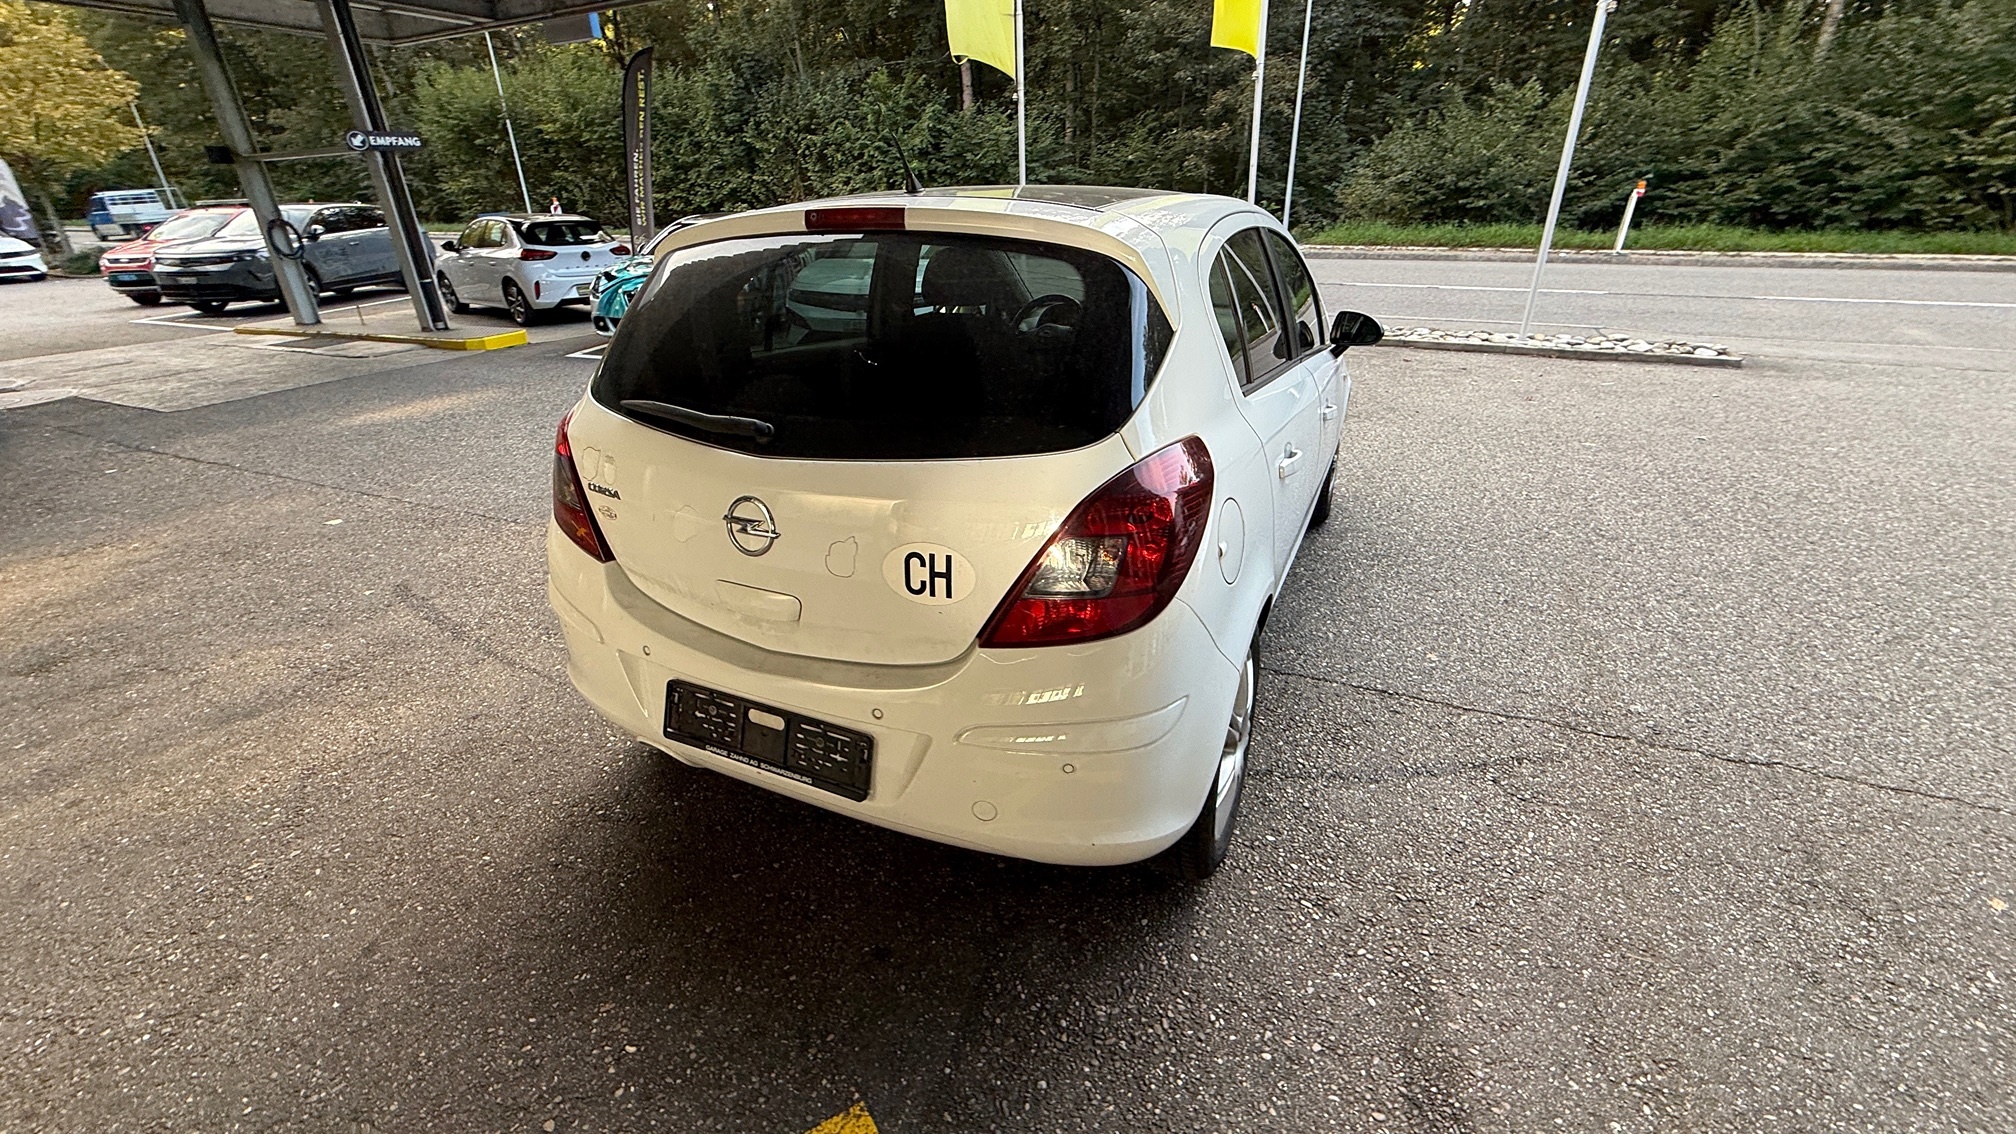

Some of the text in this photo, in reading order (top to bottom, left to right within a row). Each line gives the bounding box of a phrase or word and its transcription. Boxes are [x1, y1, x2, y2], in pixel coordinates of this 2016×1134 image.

[638, 69, 646, 107] REST.
[369, 136, 421, 146] EMPFANG
[904, 551, 952, 599] CH
[705, 744, 813, 784] GARAGE ZAHND AG SCHWARZENBURG
